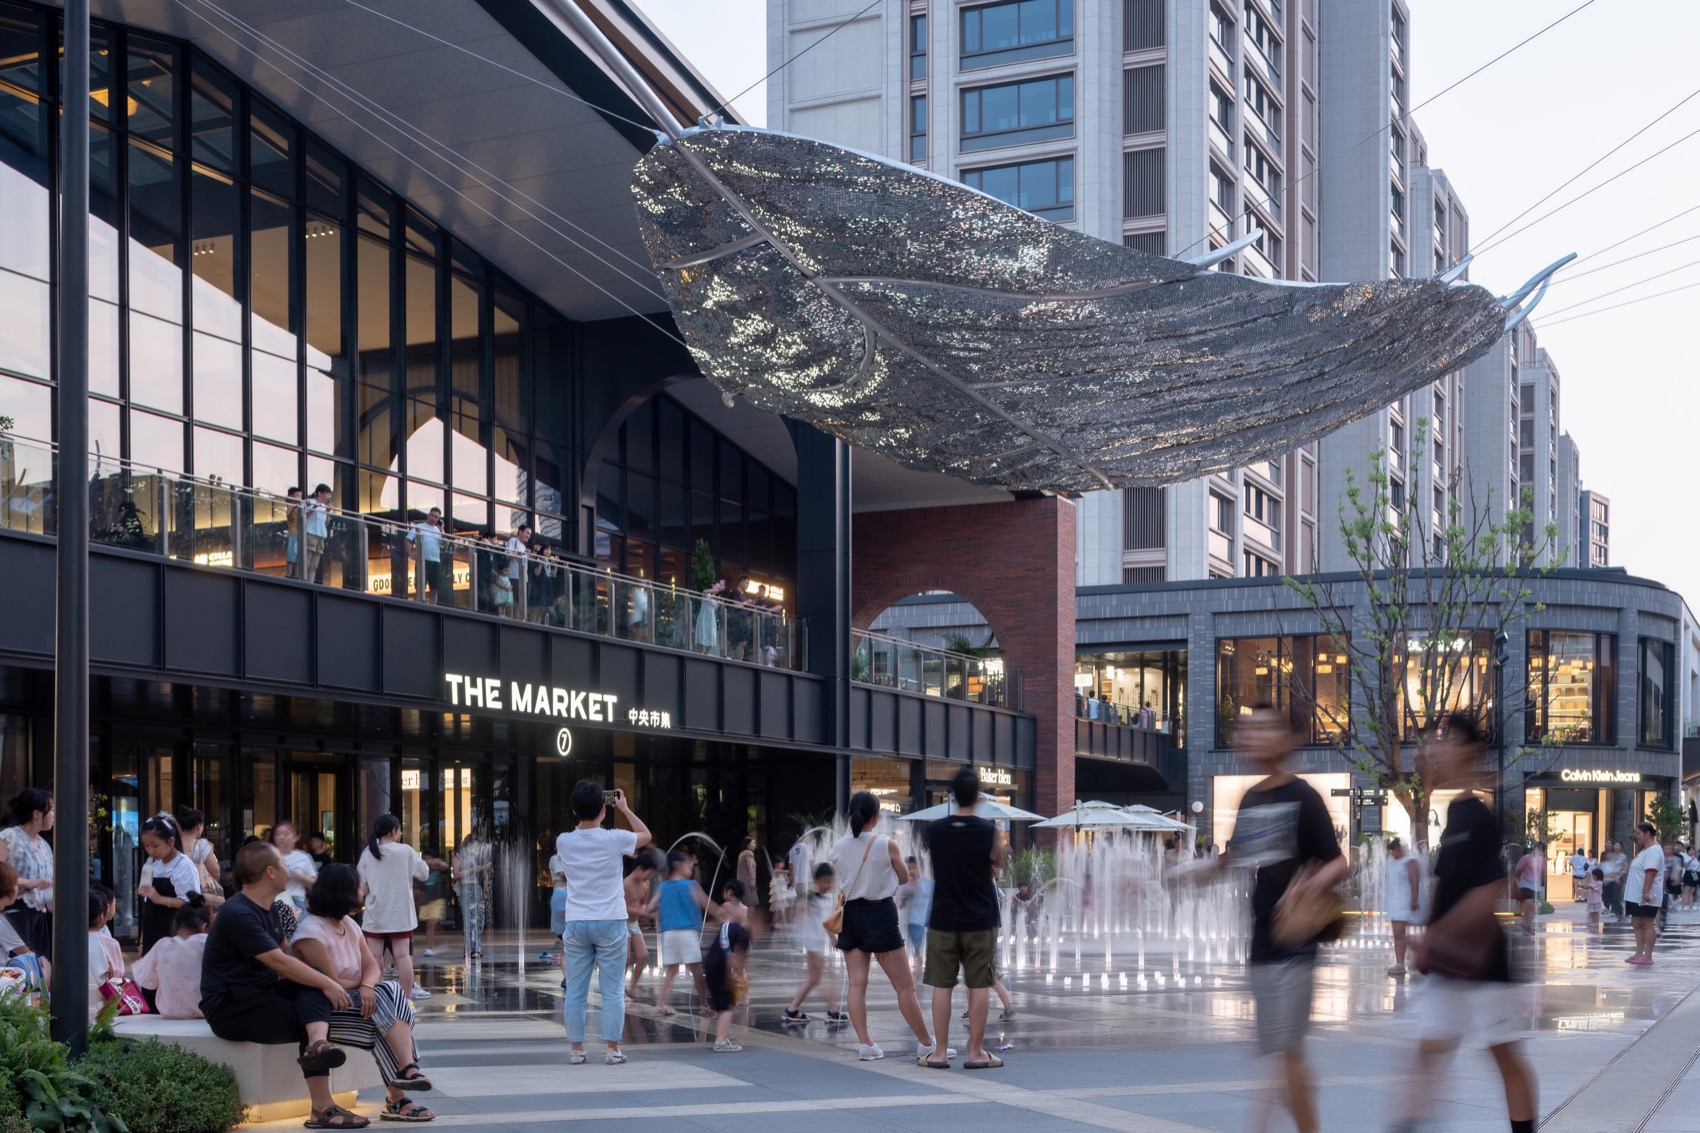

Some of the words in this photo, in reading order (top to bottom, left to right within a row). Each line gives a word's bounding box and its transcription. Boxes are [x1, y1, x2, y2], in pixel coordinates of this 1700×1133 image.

[445, 673, 503, 709] THE
[511, 681, 617, 722] MARKET
[628, 708, 671, 729] 中央市集
[980, 767, 998, 783] Baker
[998, 768, 1011, 784] bleu
[1561, 769, 1592, 781] Calvin
[1592, 769, 1614, 782] Klein
[1614, 770, 1640, 782] Jeans
